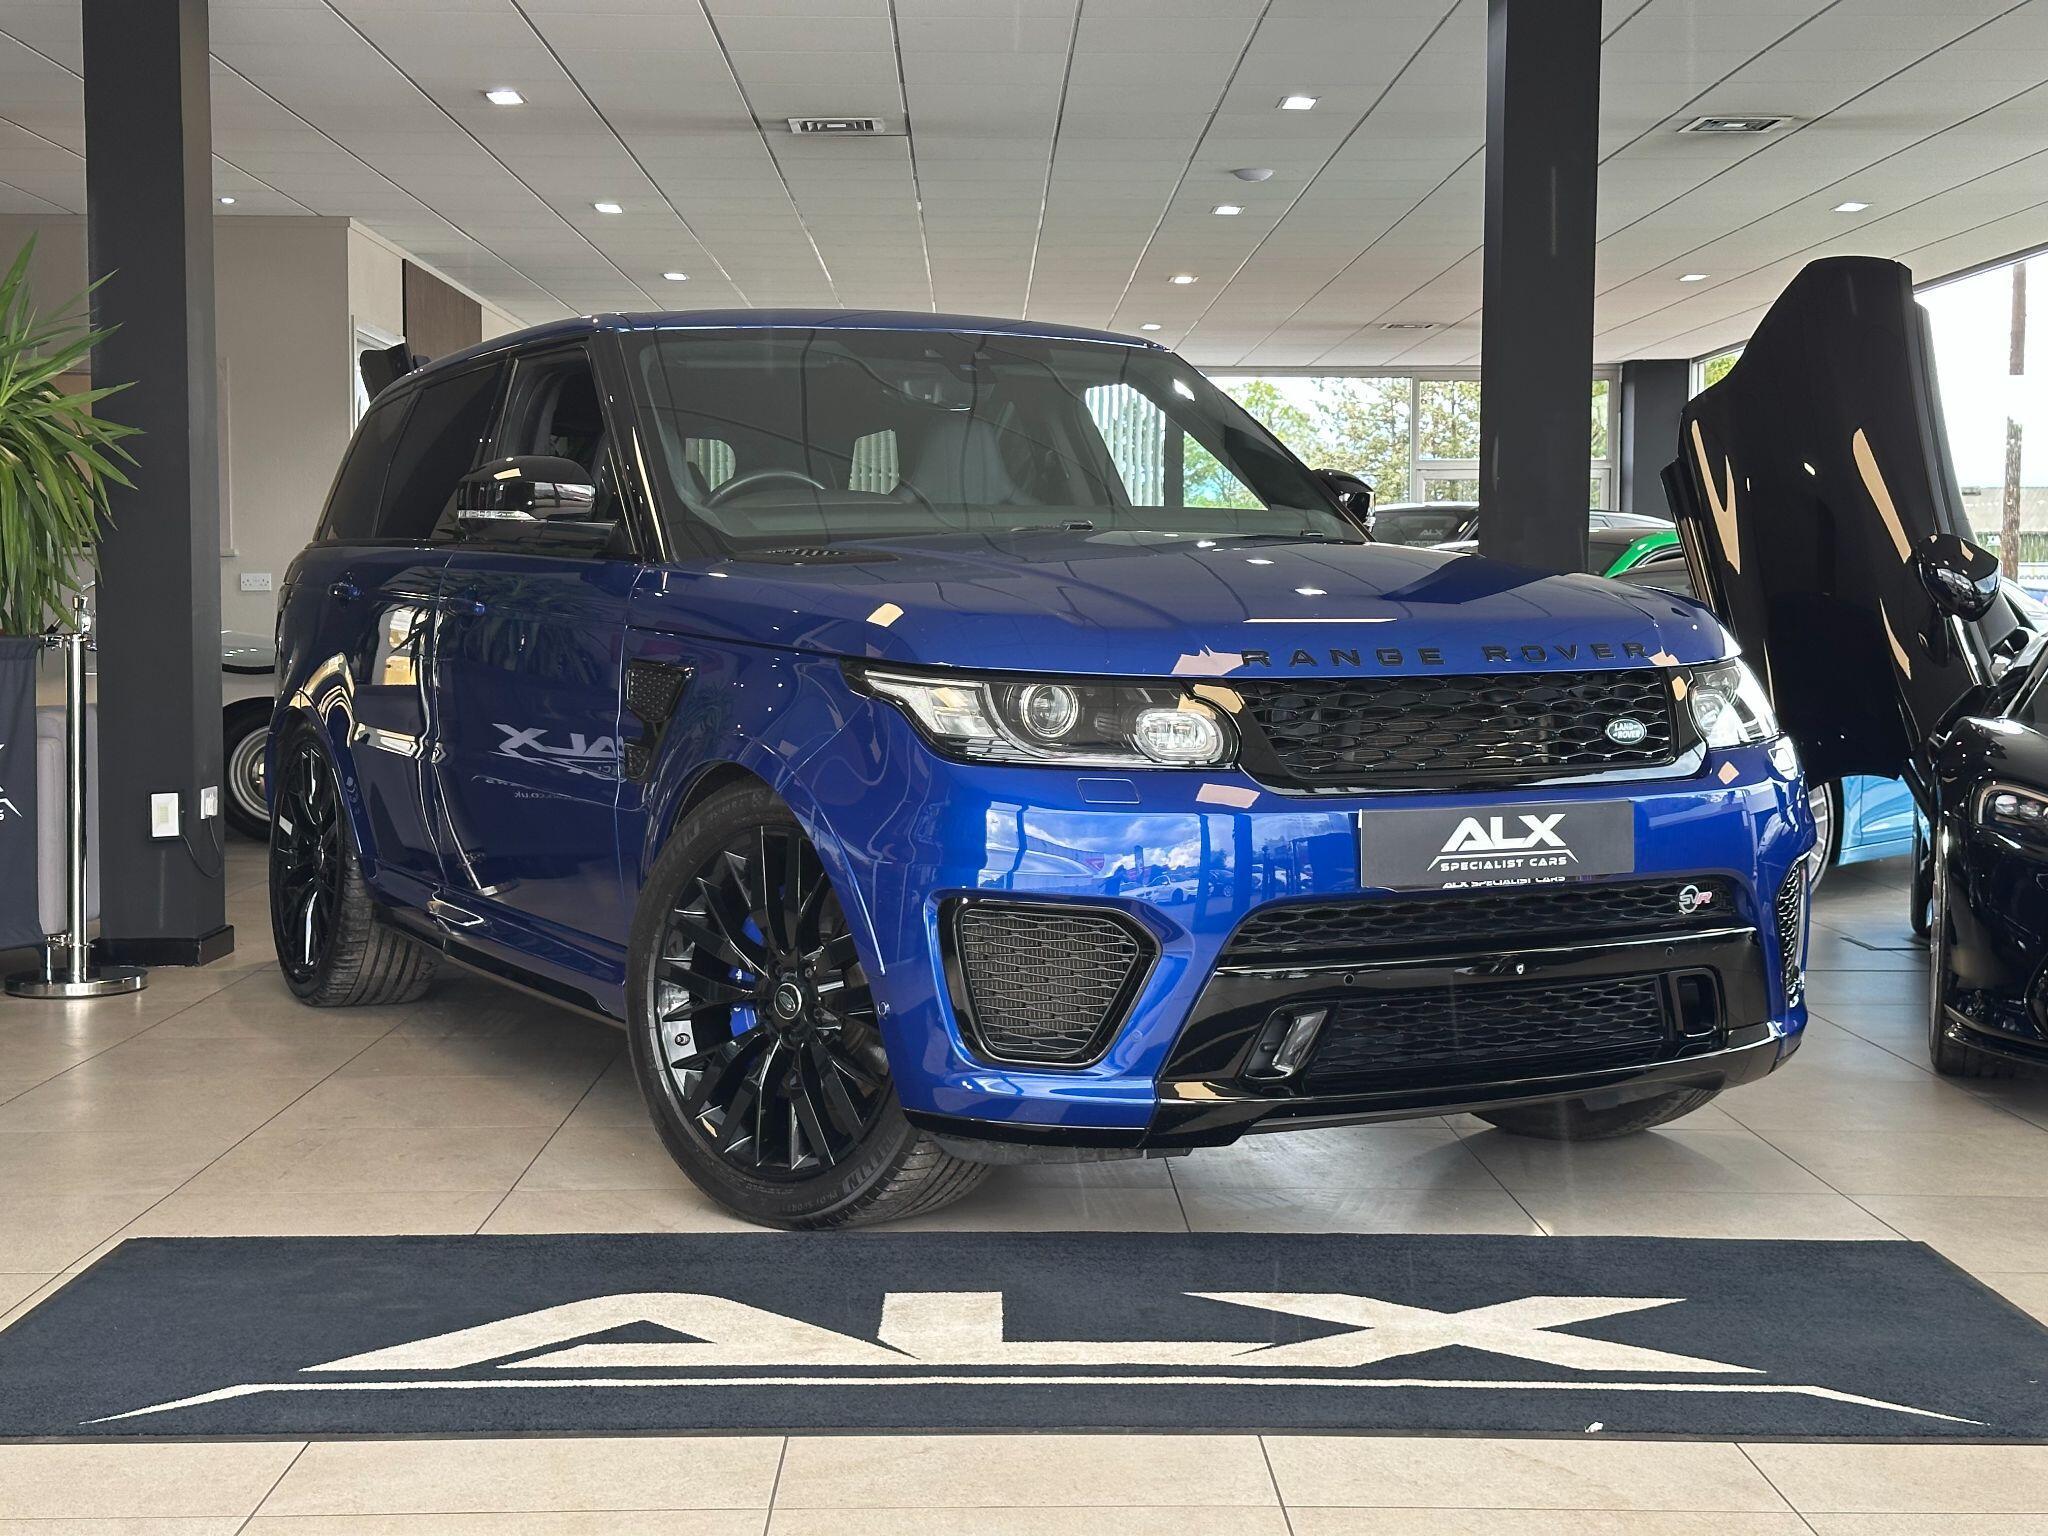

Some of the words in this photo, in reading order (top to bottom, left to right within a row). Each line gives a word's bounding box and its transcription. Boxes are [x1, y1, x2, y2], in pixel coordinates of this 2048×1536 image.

[1241, 647, 1445, 668] RANGE
[1482, 642, 1650, 662] ROVER
[1614, 722, 1634, 731] LAND
[1440, 813, 1566, 852] ALX
[1440, 858, 1525, 872] SPECIALIST
[1529, 856, 1567, 867] CARS
[298, 1291, 1768, 1374] ALX
